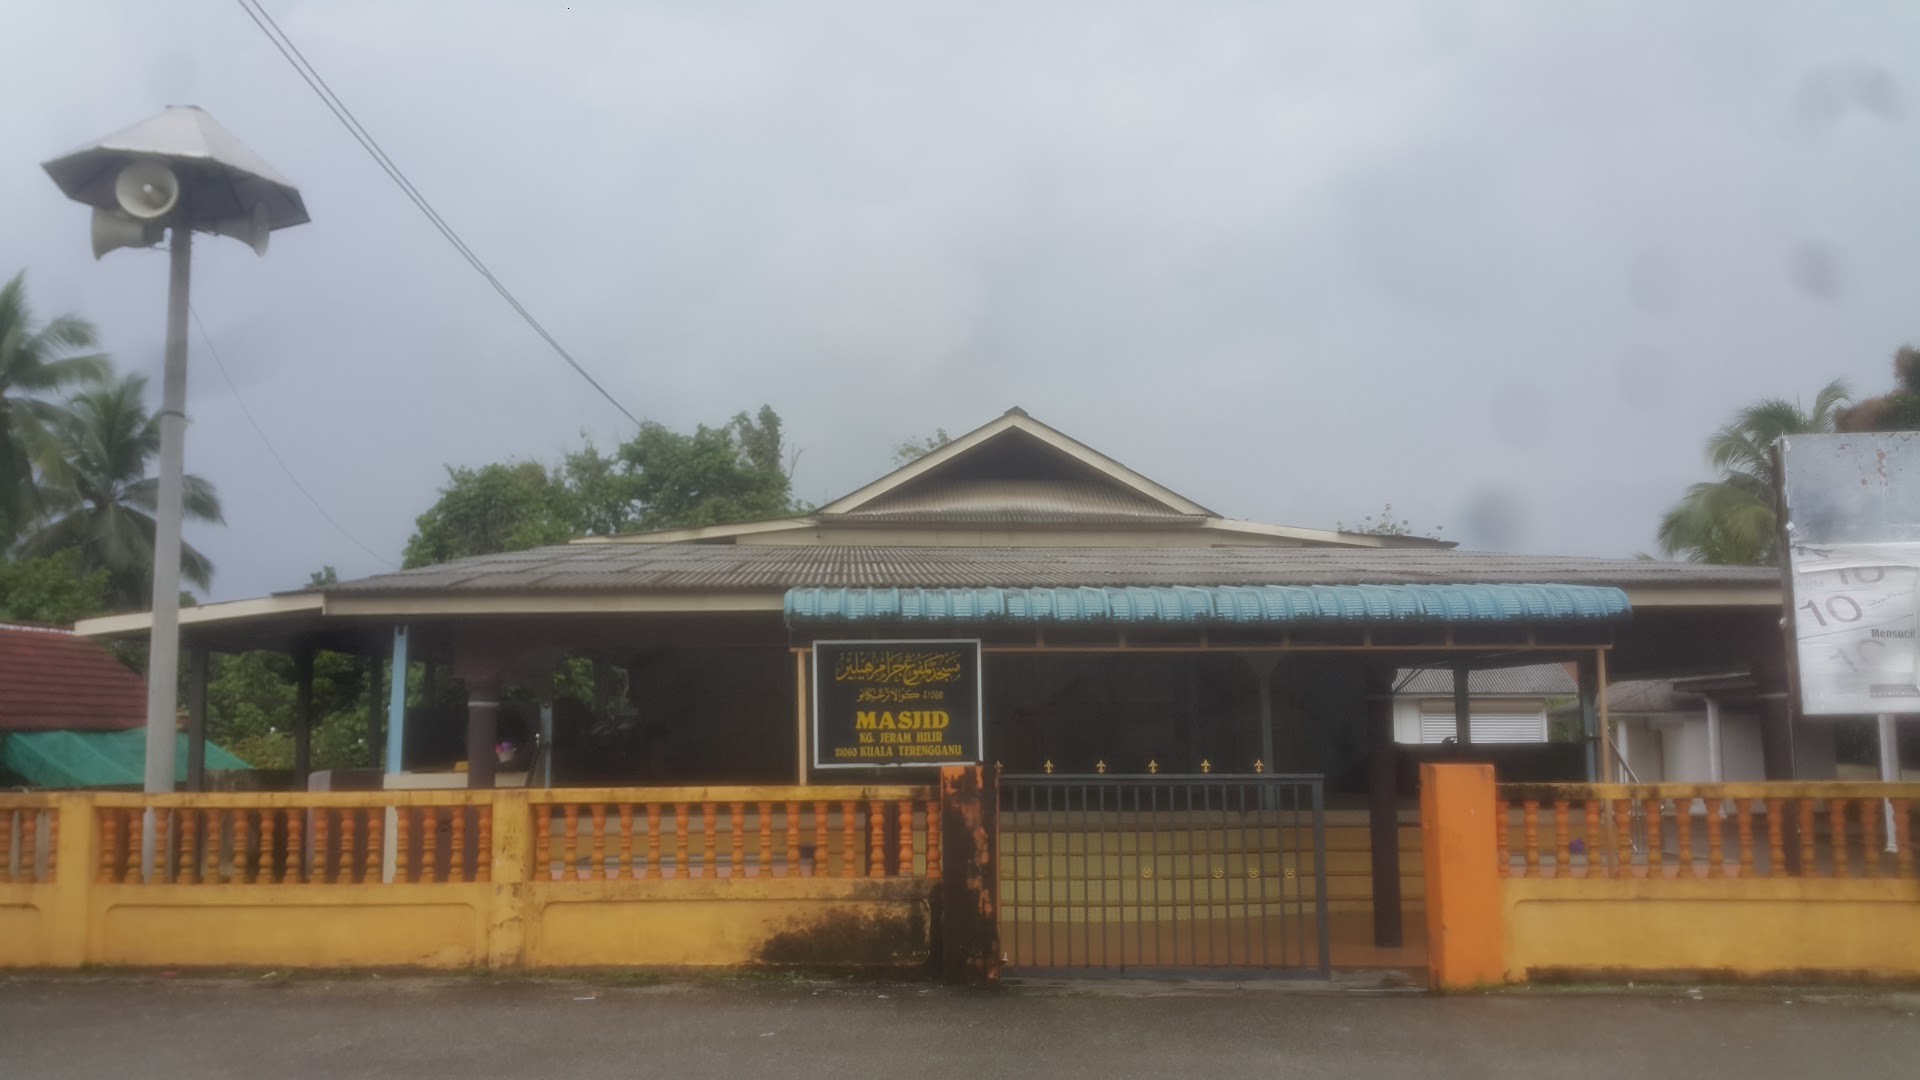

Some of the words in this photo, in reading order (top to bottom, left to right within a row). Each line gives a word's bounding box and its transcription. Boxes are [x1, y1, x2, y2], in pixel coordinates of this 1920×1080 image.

[1799, 595, 1863, 626] 10
[856, 711, 950, 729] MASJID
[860, 732, 876, 743] KG.
[880, 732, 912, 743] JERAM
[916, 731, 943, 743] HILIR
[860, 746, 893, 757] KUALA
[898, 745, 962, 757] TERENGGANU
